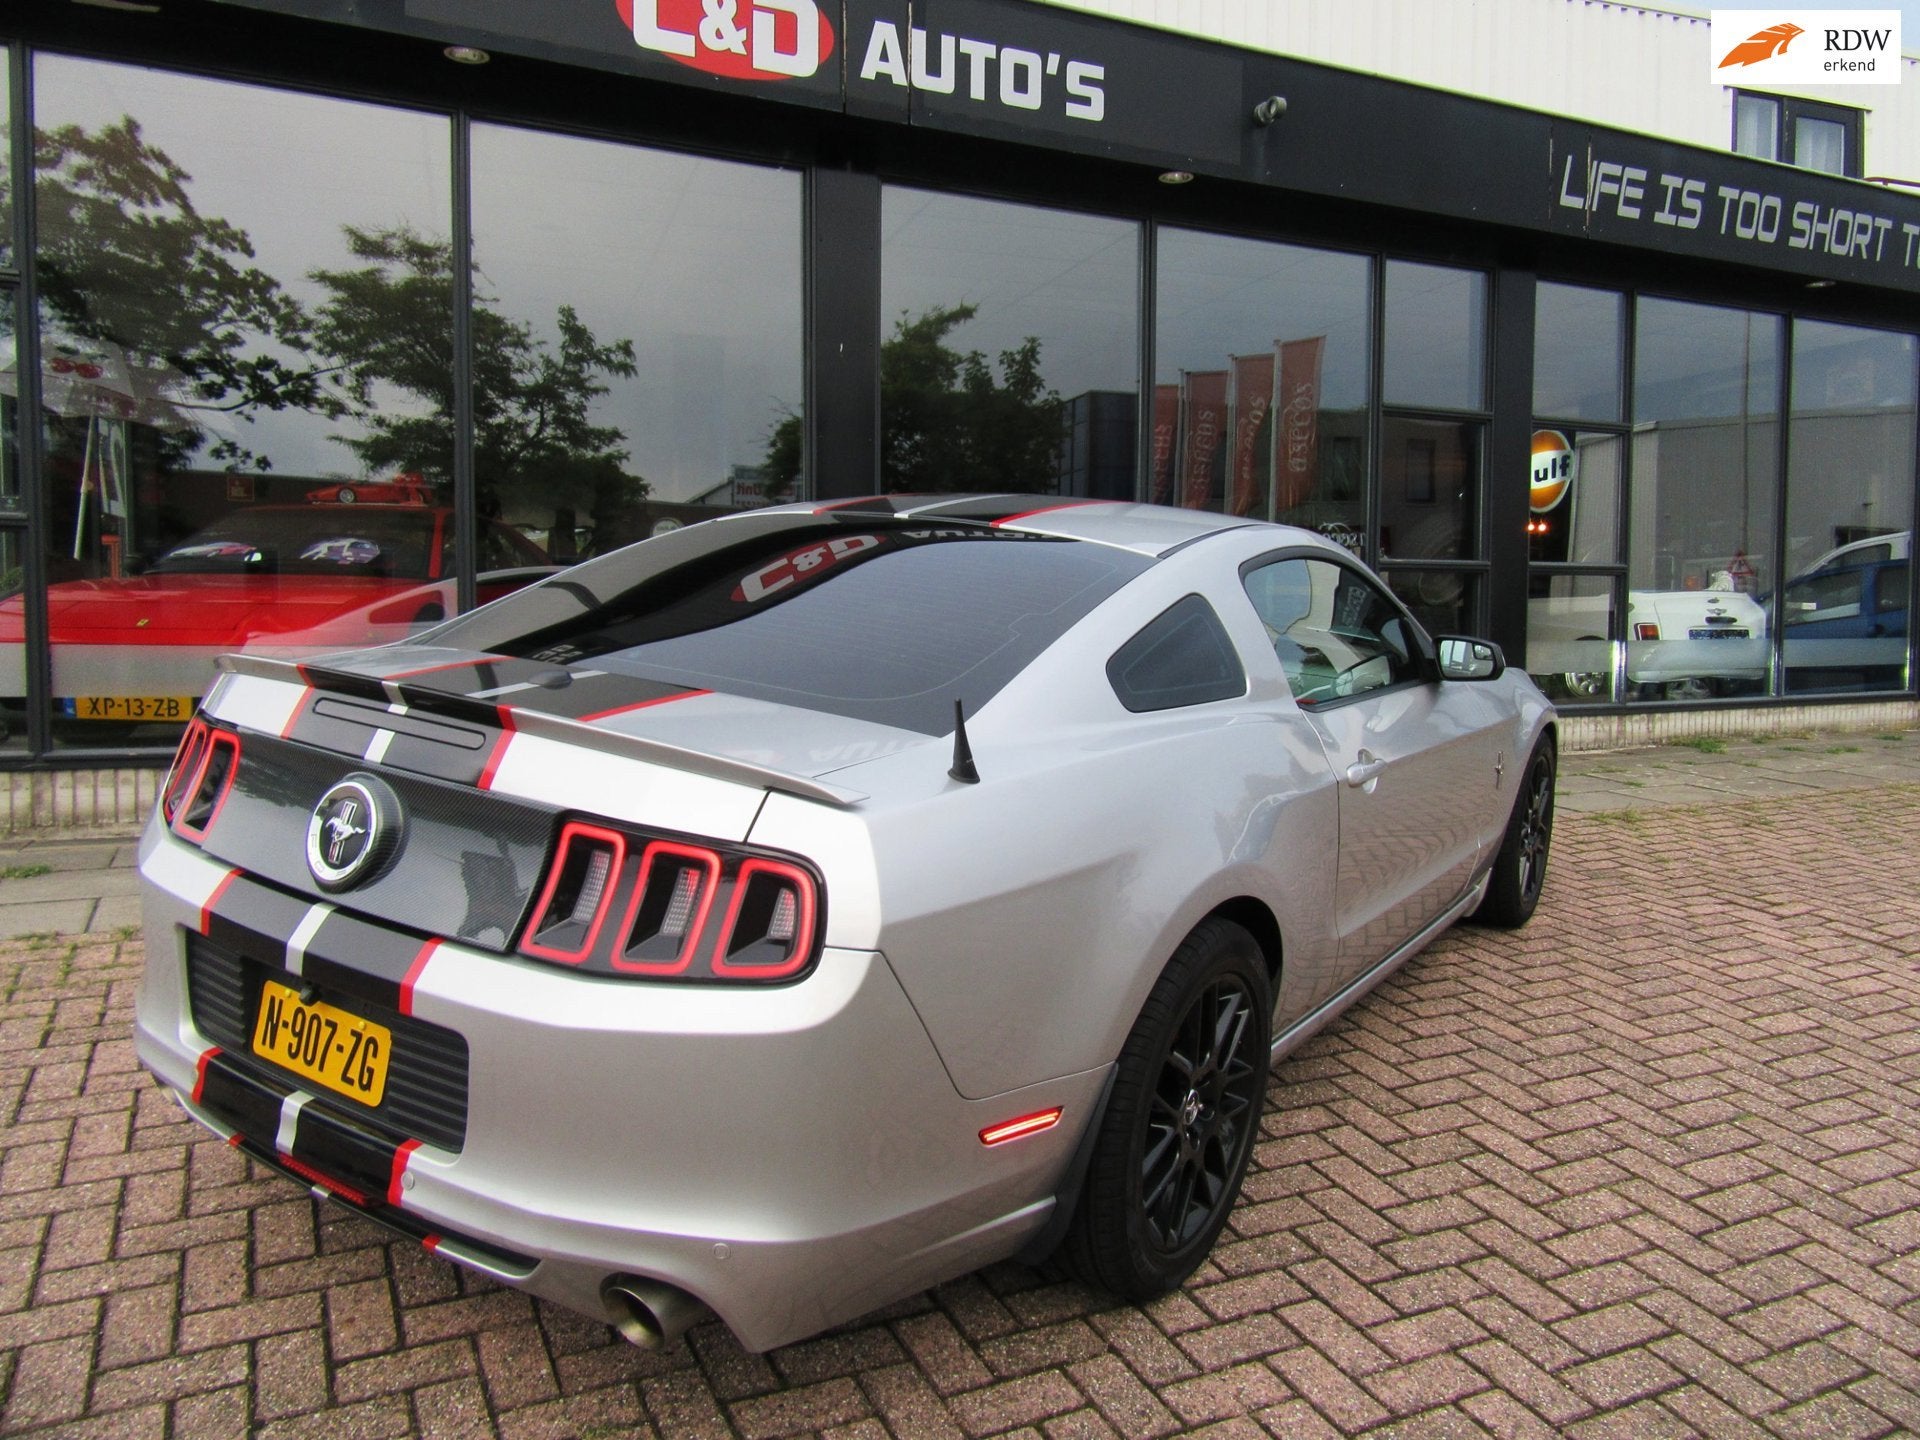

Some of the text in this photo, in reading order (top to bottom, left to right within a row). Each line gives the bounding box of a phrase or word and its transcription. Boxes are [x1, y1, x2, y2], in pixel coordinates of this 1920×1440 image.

[860, 20, 1105, 121] AUTO'S
[1559, 155, 1920, 269] LIFE IS TOO SHORT T
[1534, 454, 1571, 482] ulf
[88, 697, 180, 717] XP-13-ZB
[262, 995, 379, 1092] N-907-ZG
